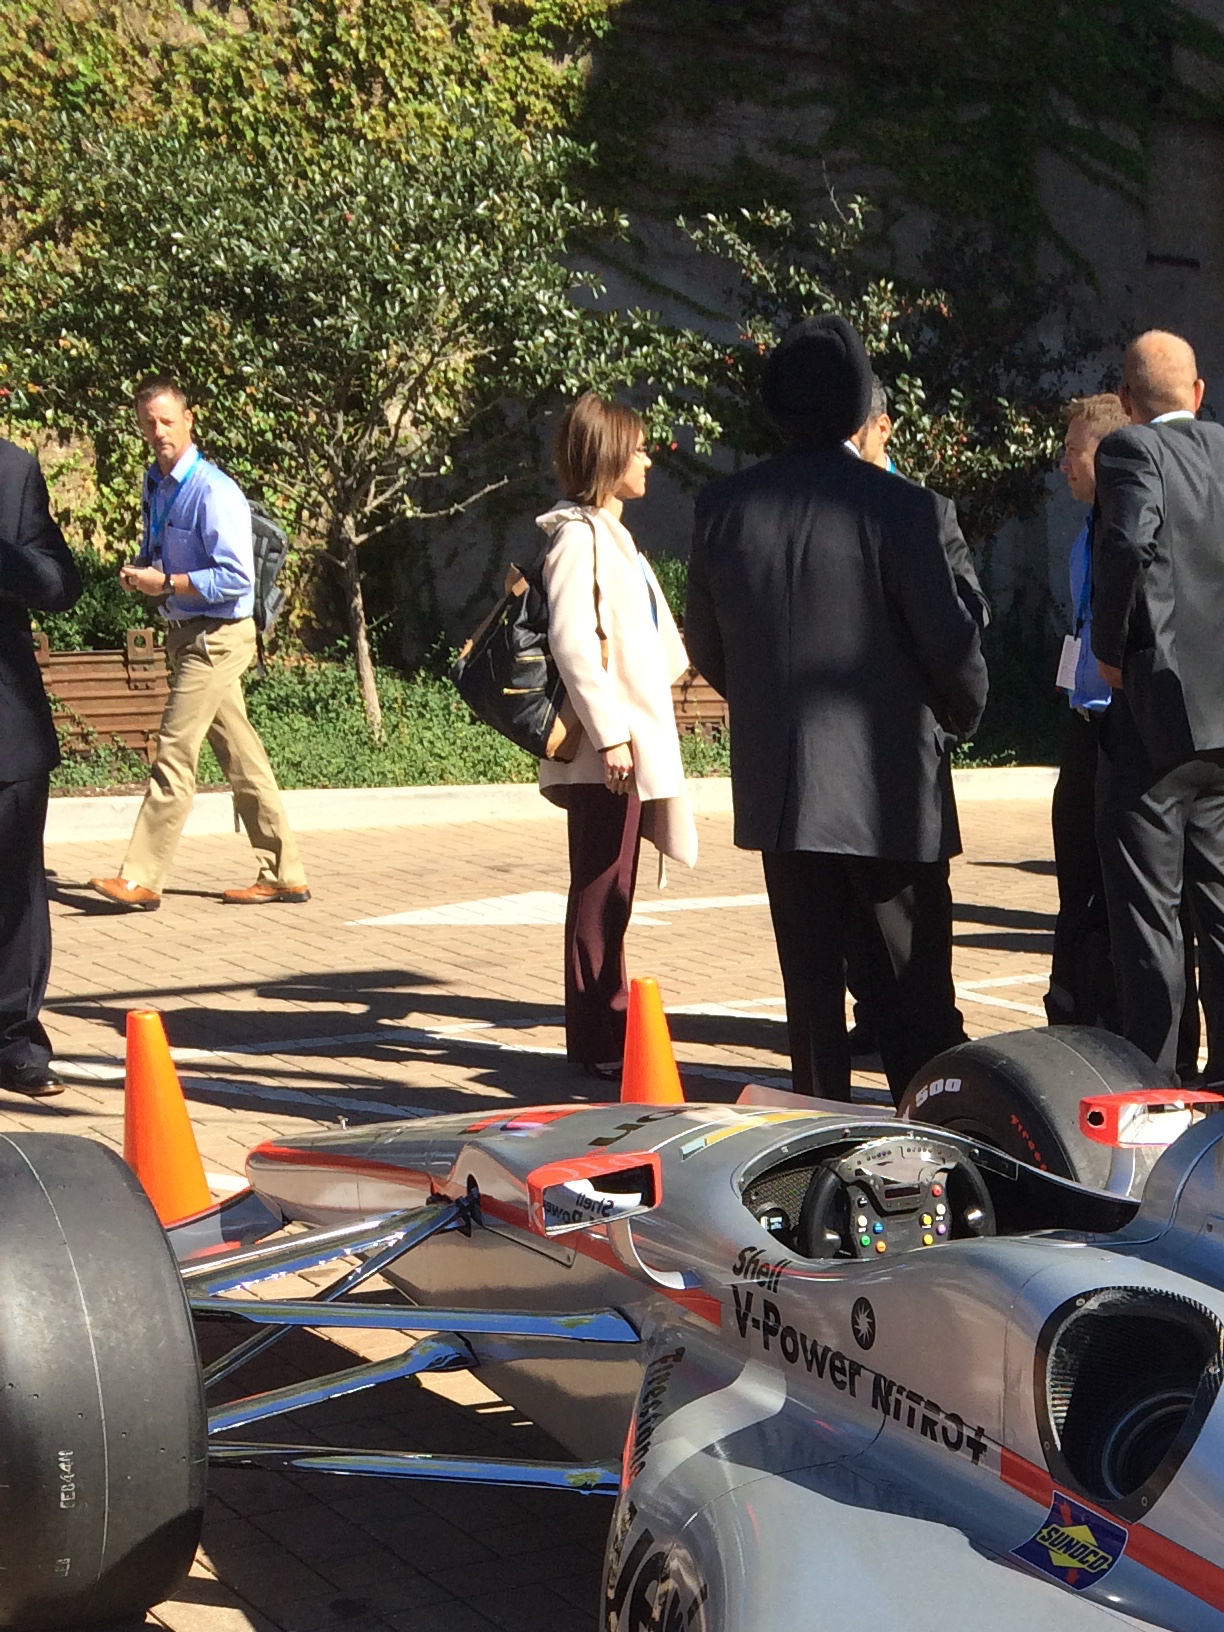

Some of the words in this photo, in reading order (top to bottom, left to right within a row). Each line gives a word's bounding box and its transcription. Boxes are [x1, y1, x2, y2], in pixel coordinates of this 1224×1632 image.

[914, 1077, 962, 1108] 500
[732, 1246, 792, 1293] Shell
[731, 1284, 863, 1398] V-Power
[1037, 1525, 1110, 1574] SUNOCO
